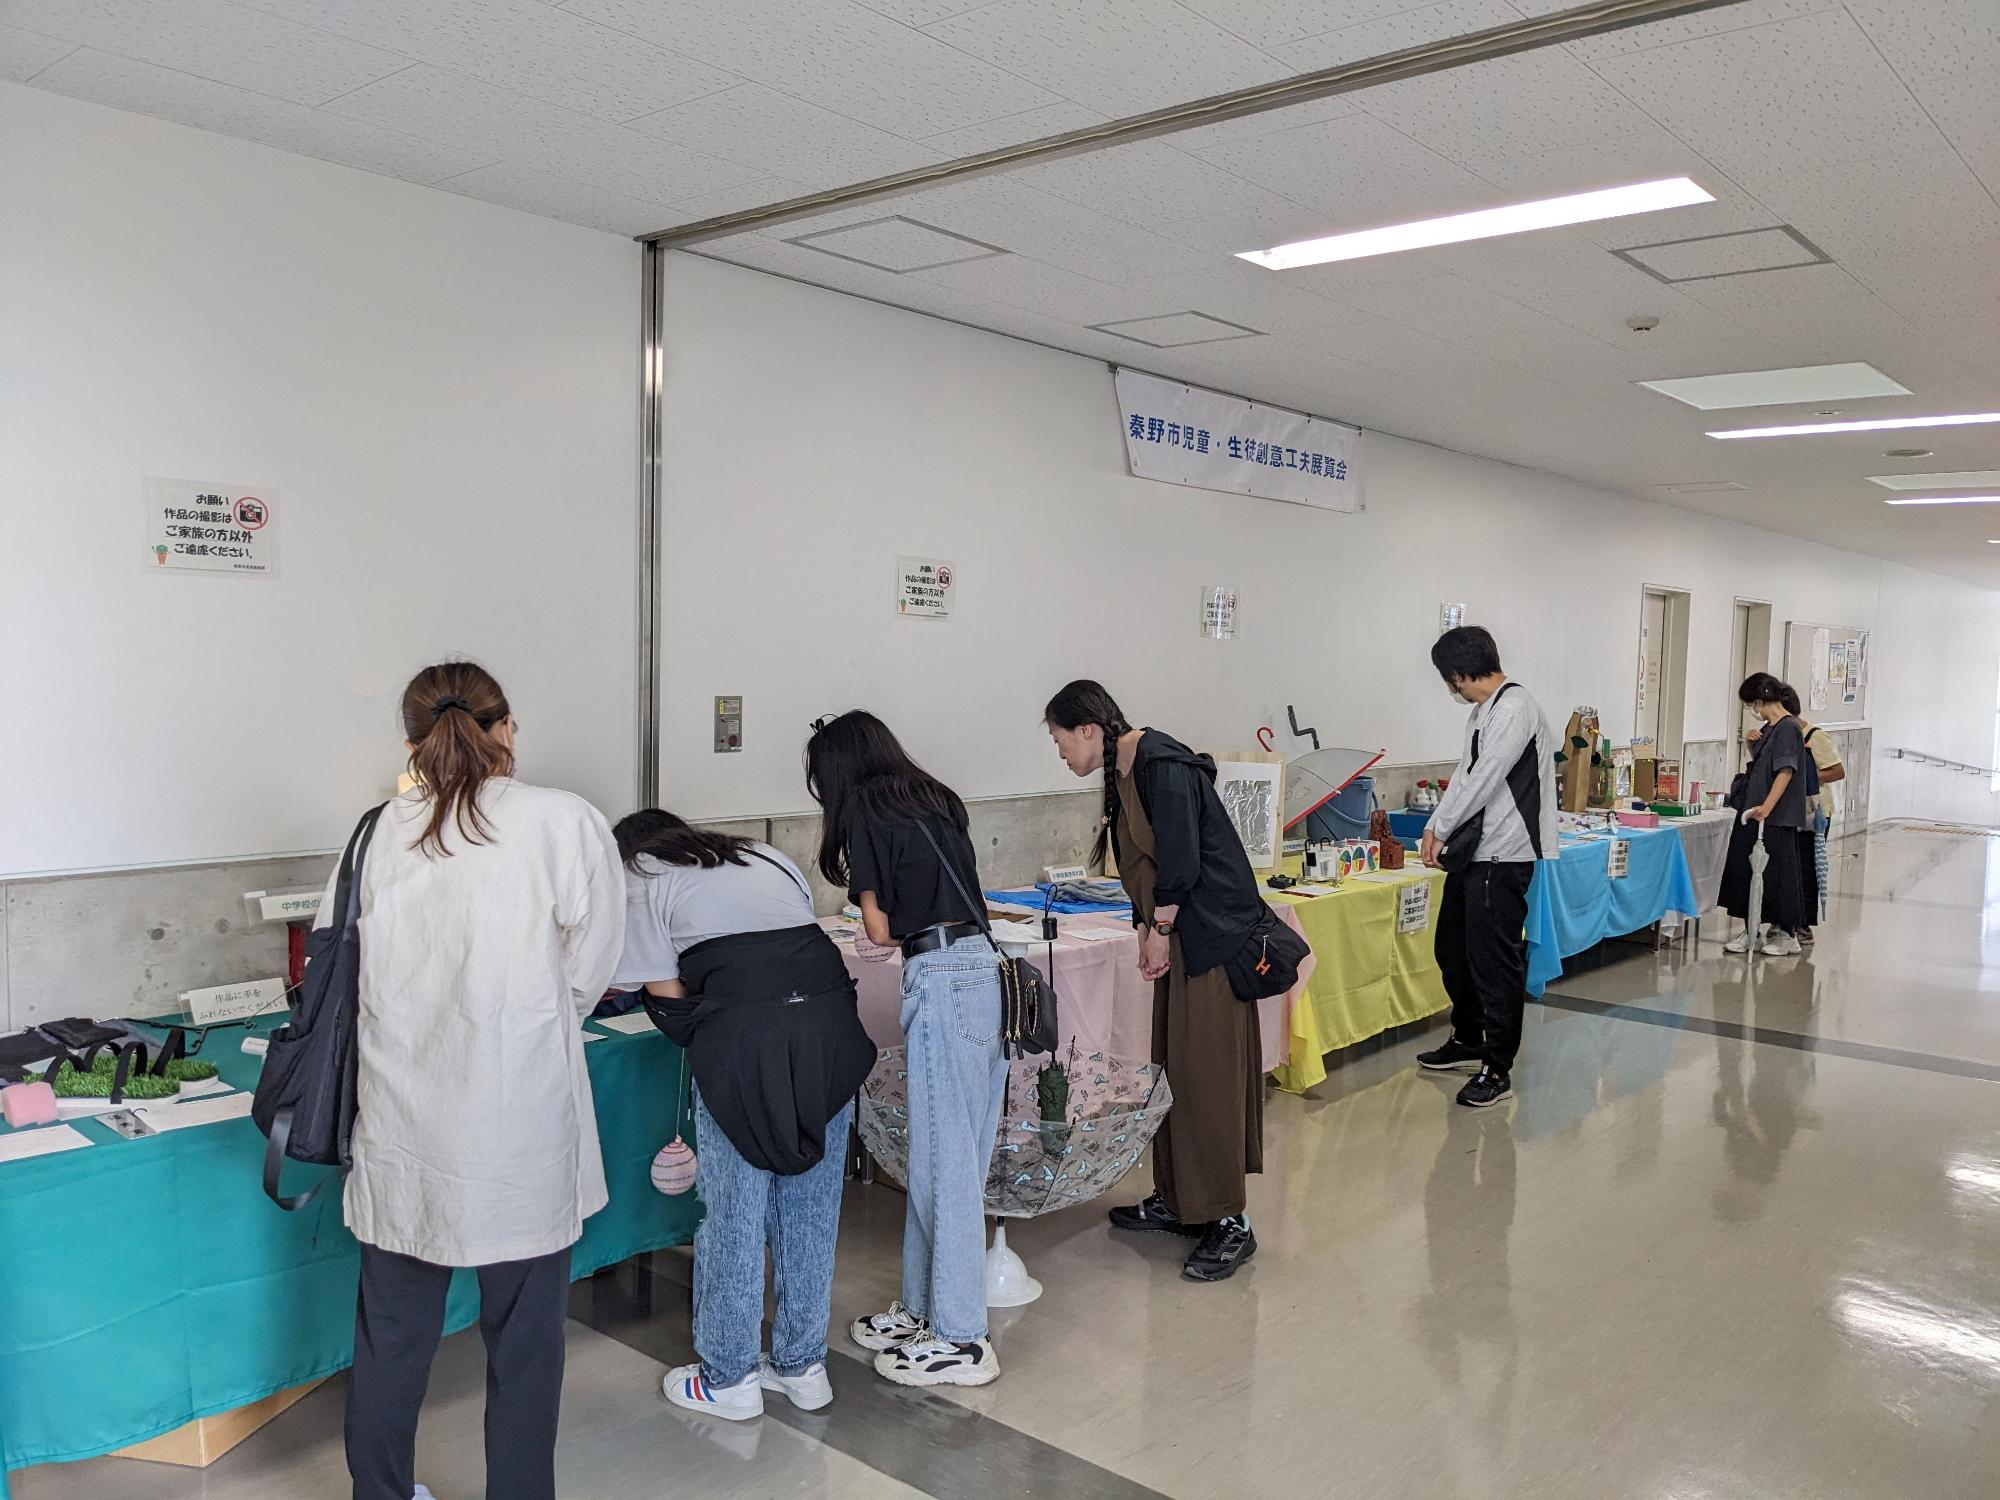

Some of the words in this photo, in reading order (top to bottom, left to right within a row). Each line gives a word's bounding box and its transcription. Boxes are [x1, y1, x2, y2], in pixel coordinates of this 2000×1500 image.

[1129, 413, 1348, 482] 秦野市児童・生徒創意工夫展覧会
[196, 494, 229, 506] お願い
[164, 508, 233, 523] 作品の撮影は
[165, 525, 254, 543] ご家族の方以外
[174, 543, 253, 559] ご遠慮ください。
[281, 899, 321, 911] 中学校の
[215, 988, 262, 1004] 作品に手を
